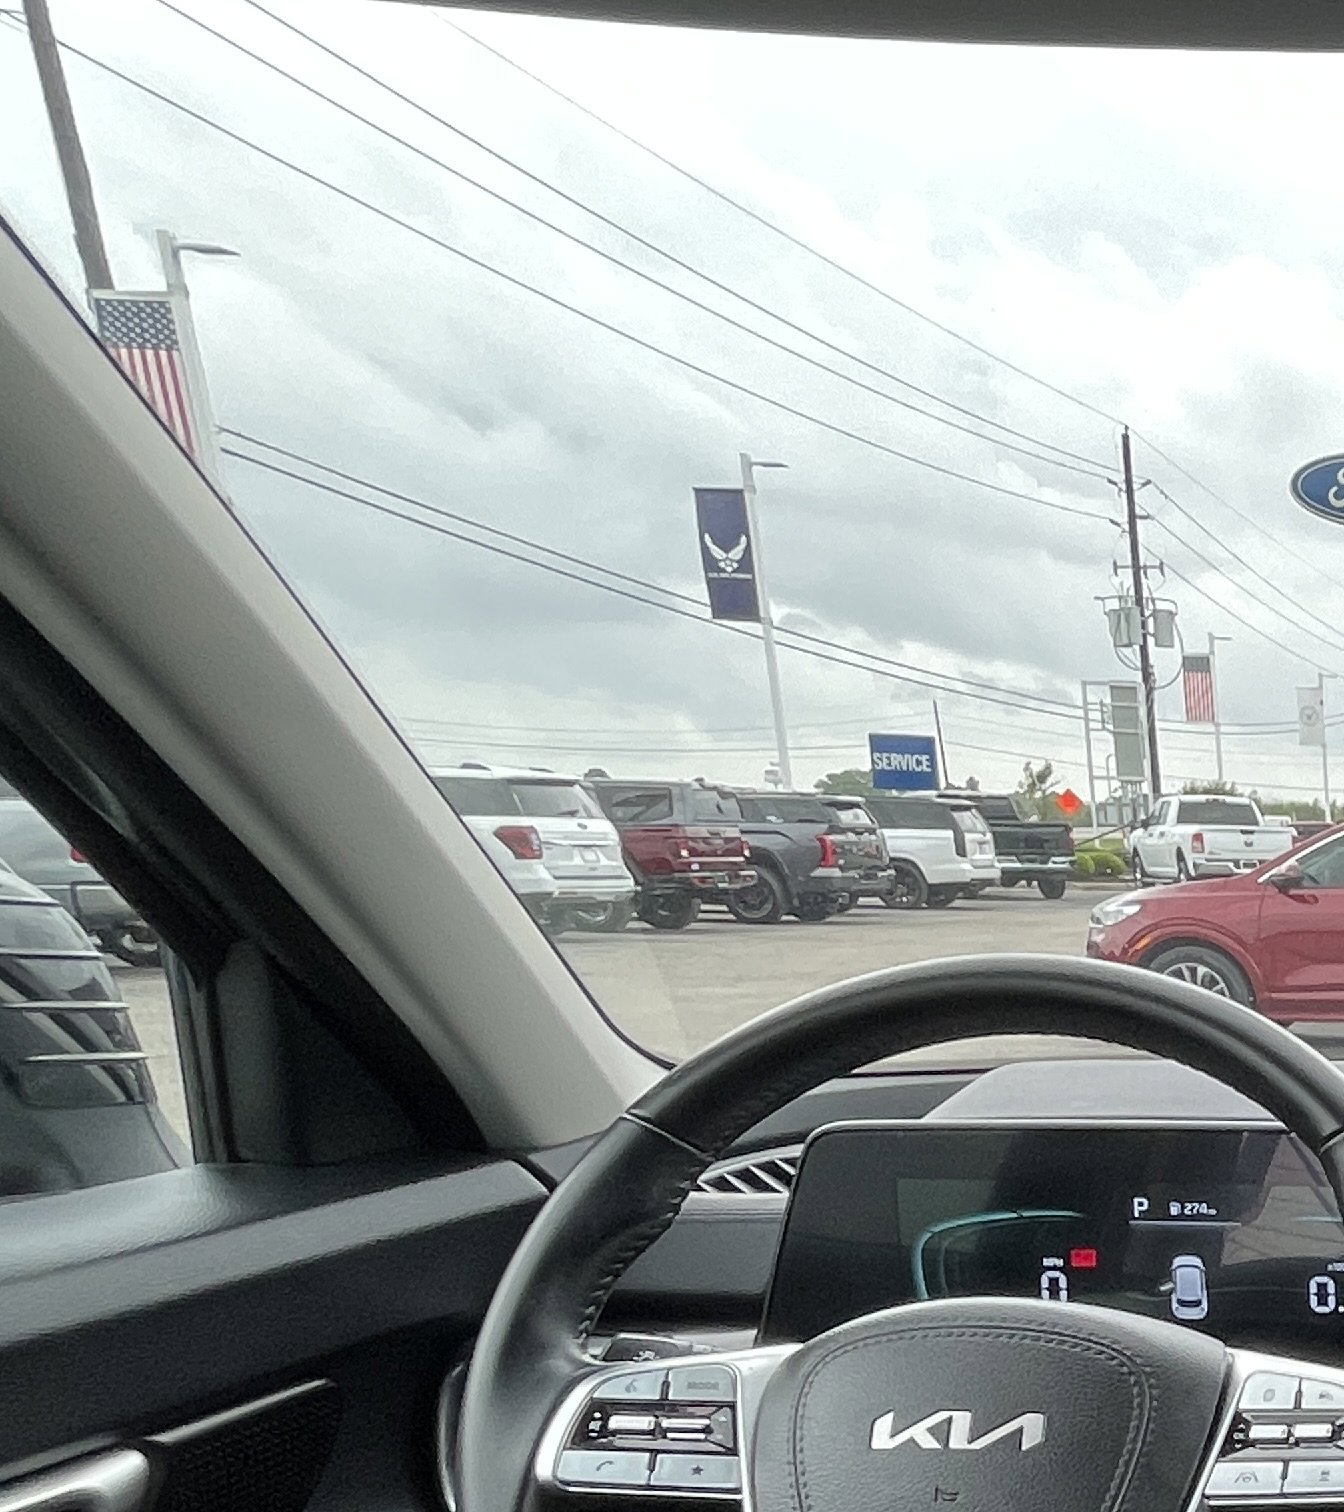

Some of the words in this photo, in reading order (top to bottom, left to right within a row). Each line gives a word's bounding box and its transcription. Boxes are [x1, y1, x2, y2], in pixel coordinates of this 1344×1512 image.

[872, 752, 932, 773] SERVICE
[1132, 1197, 1149, 1217] P
[867, 1408, 1047, 1451] KIA
